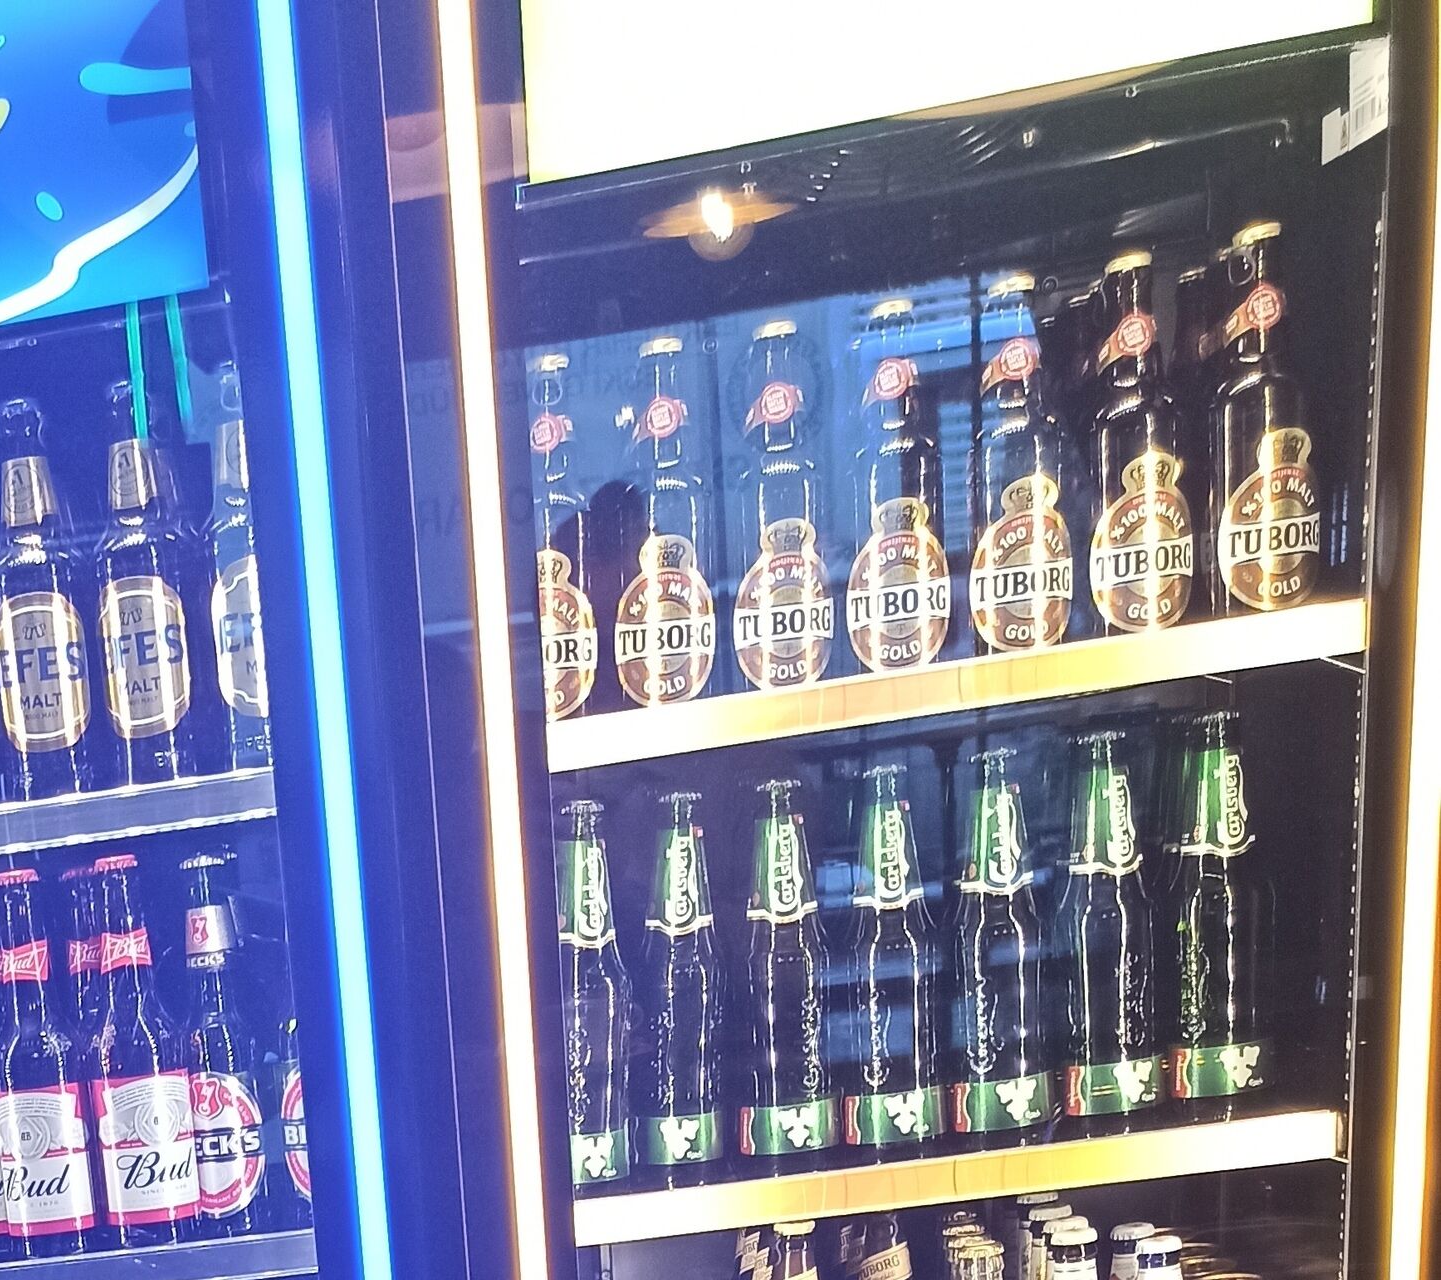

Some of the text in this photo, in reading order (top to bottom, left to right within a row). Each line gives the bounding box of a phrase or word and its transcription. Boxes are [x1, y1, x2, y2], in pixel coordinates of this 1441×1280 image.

[1155, 501, 1185, 531] MALT
[1229, 518, 1319, 558] TUBORG
[1096, 542, 1191, 582] TUBORG
[976, 565, 1071, 602] TUBORG
[851, 584, 947, 623] TUBORG
[739, 605, 831, 642] TUBORG
[880, 639, 922, 661] GOLD
[20, 690, 63, 712] MALT
[1103, 773, 1136, 867] Carlsberg
[1214, 753, 1248, 849] Carlsberg
[195, 1128, 261, 1157] ECK'S
[5, 1163, 70, 1202] Bud
[116, 1146, 193, 1191] Bud
